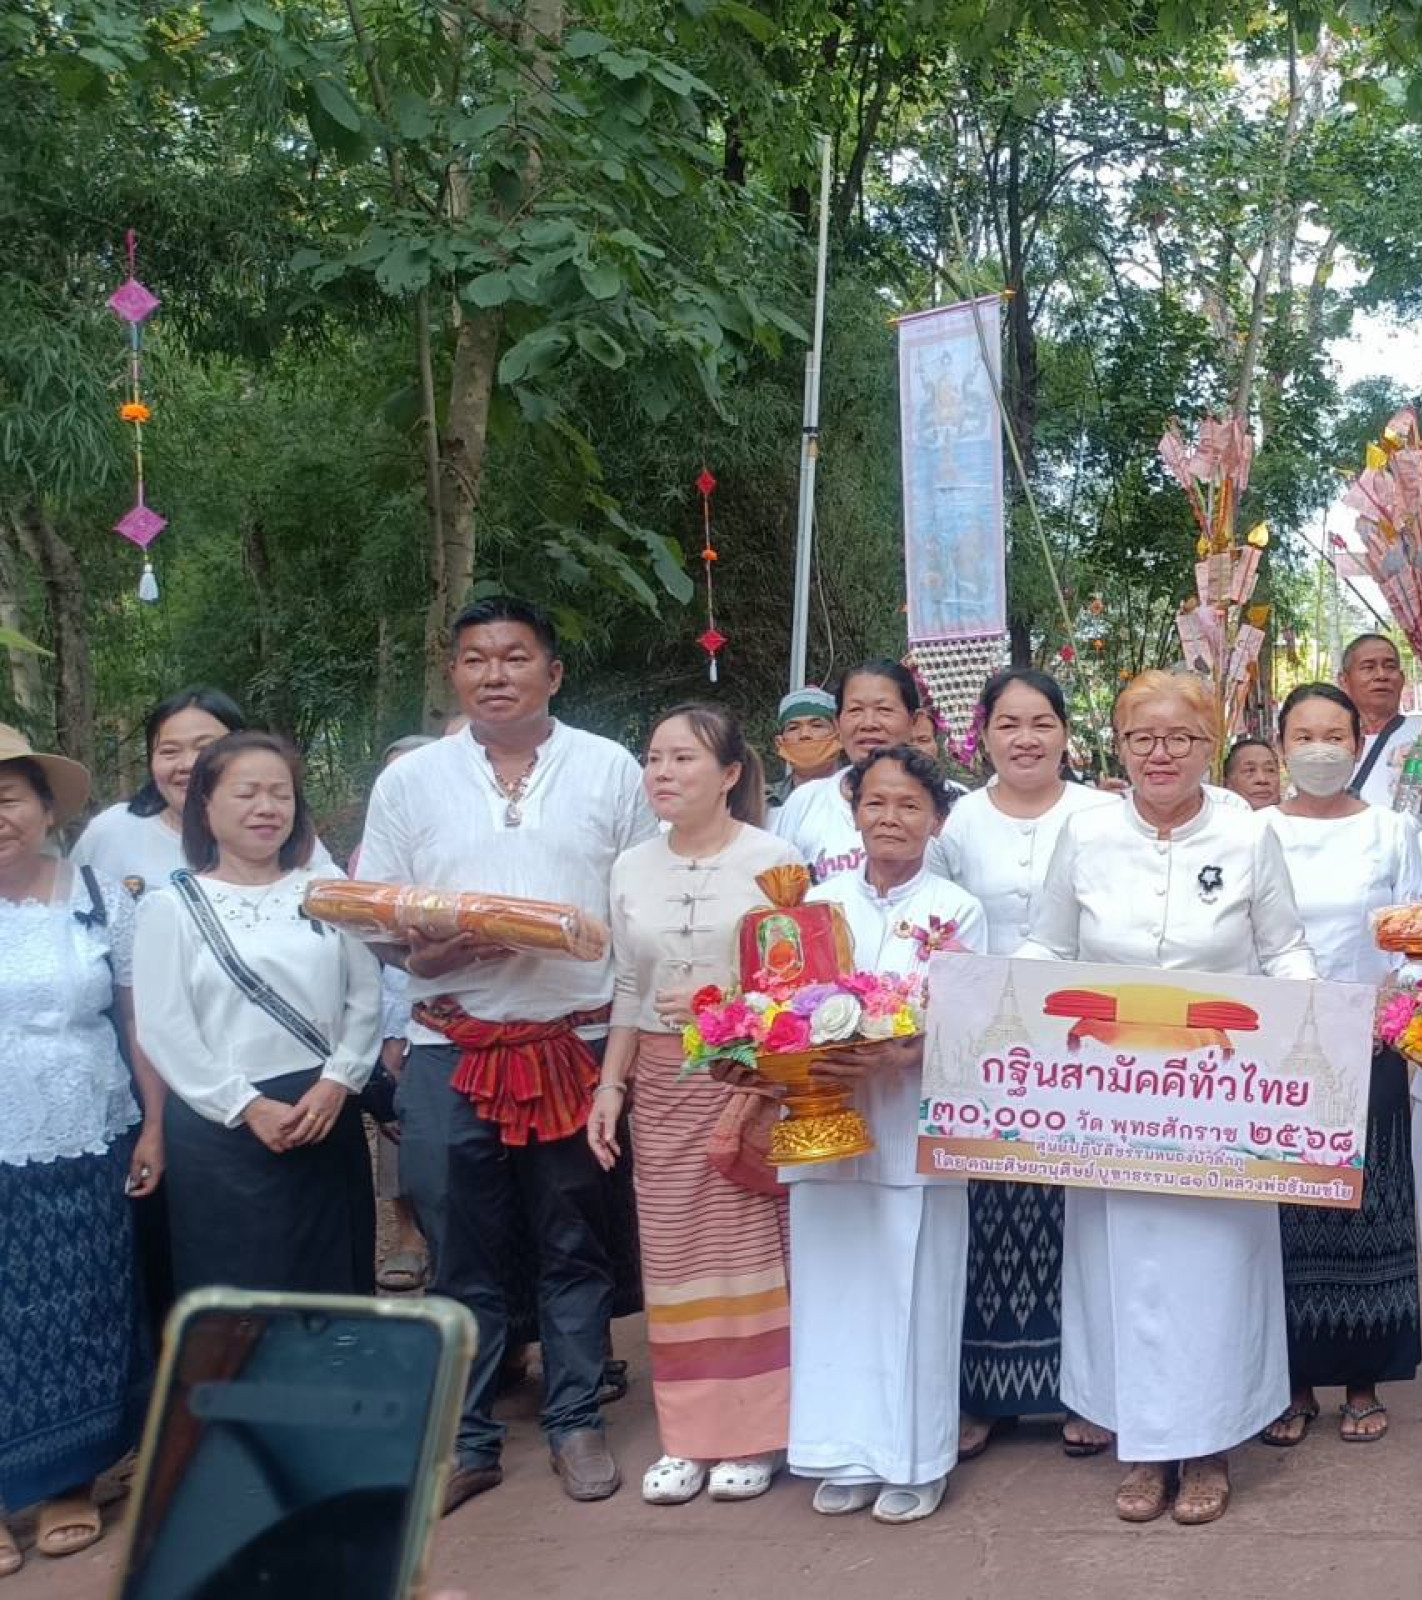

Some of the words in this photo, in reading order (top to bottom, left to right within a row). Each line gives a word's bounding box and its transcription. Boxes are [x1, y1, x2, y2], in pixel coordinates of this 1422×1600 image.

[981, 1046, 1310, 1109] กฐินสามัคคีทั่วไทย
[931, 1102, 1067, 1130] ๓๐,๐๐๐
[1076, 1109, 1103, 1133] วัด
[1110, 1115, 1238, 1144] พุทธศักราช
[1248, 1120, 1355, 1152] ๒๕๖๘
[1207, 1171, 1220, 1188] ปี
